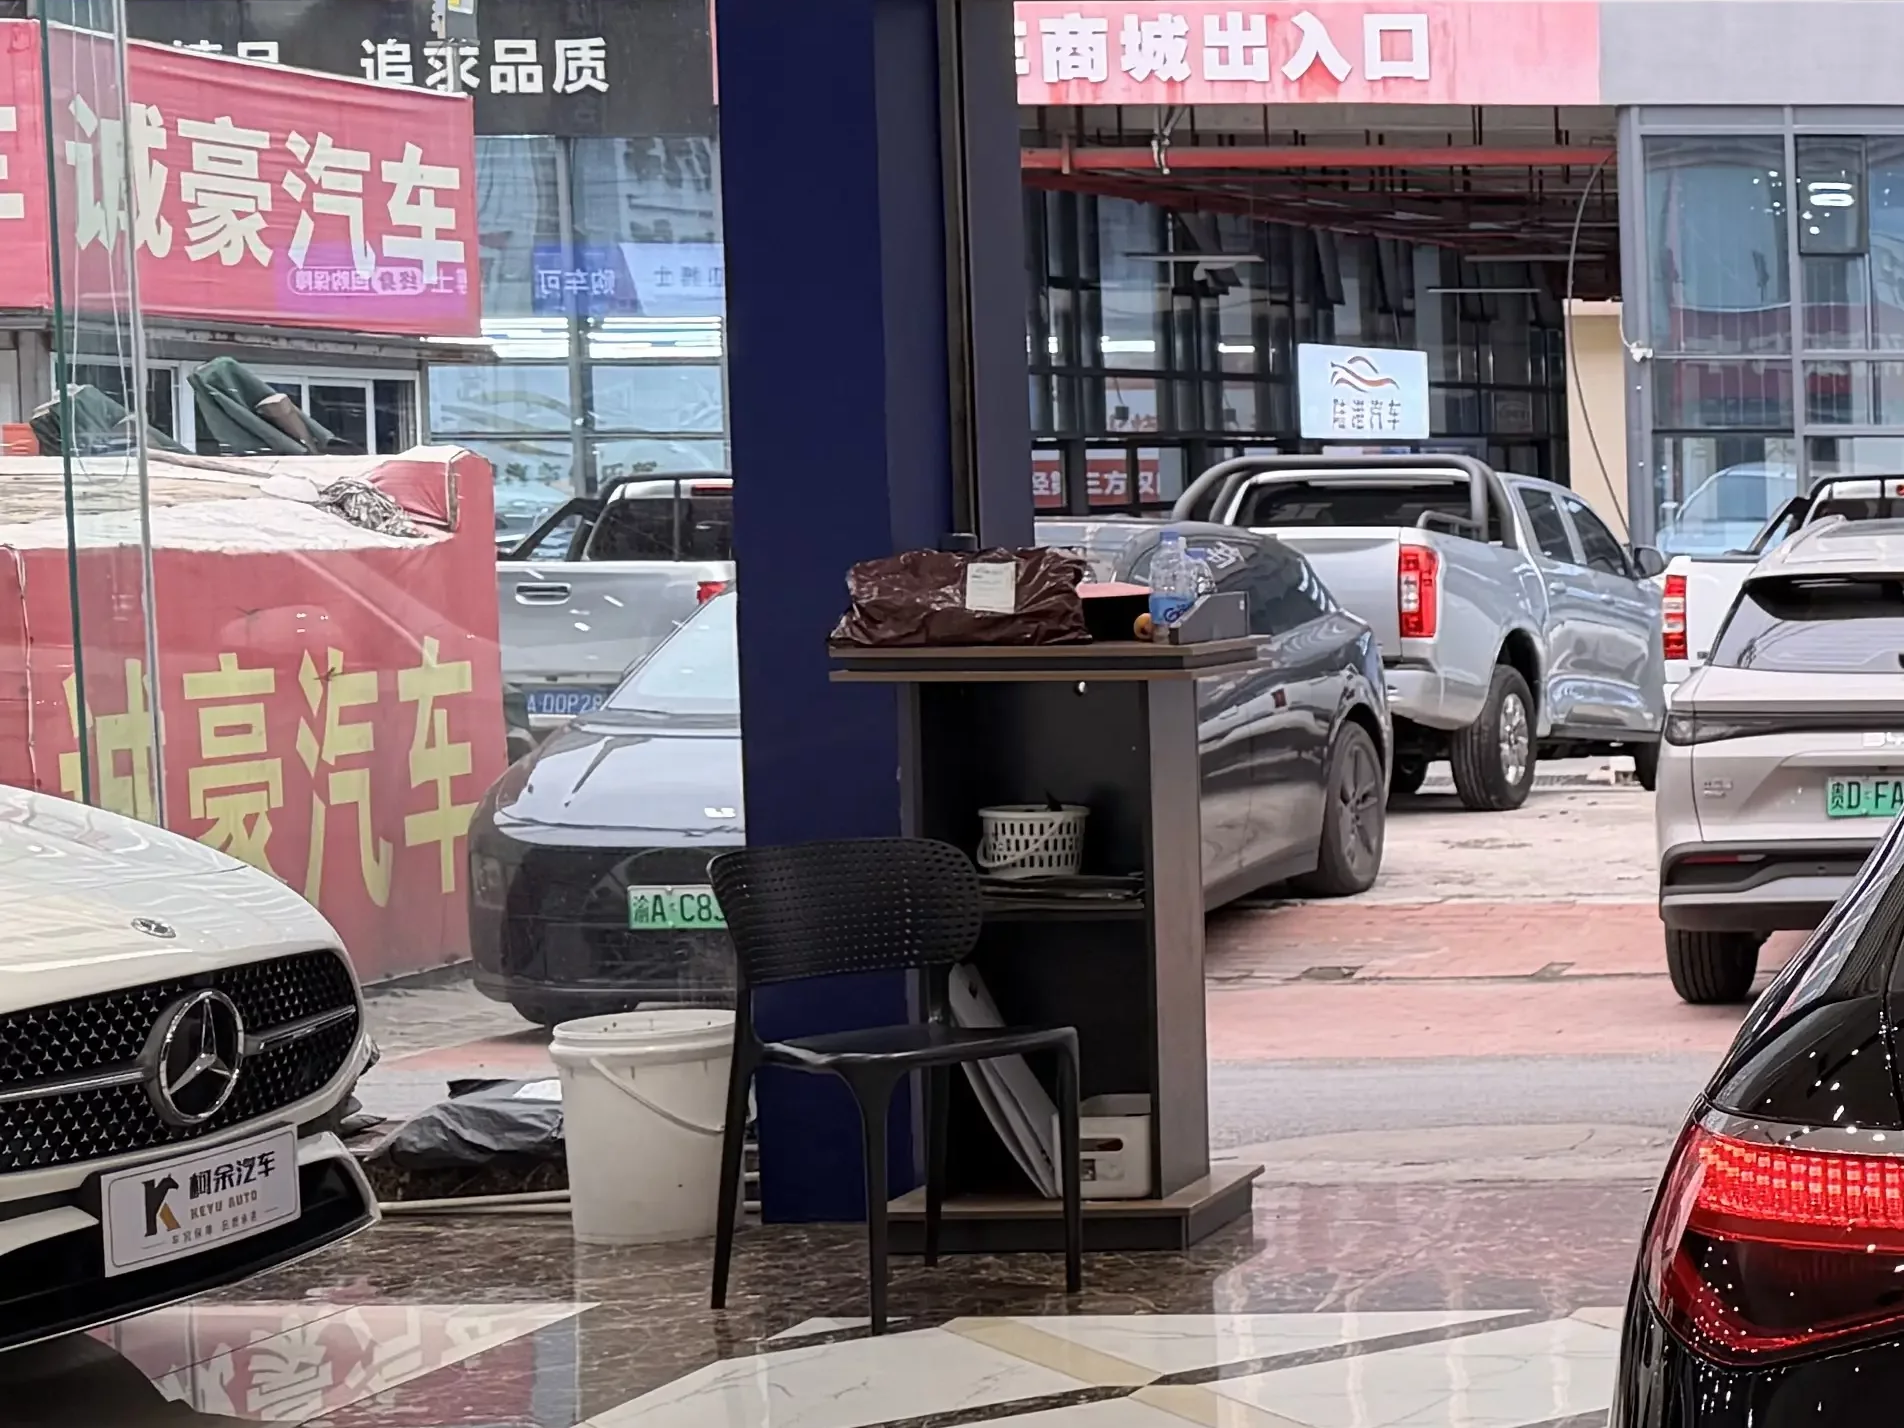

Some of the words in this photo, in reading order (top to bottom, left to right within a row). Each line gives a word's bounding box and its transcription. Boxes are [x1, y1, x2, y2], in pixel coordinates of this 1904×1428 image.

[360, 37, 610, 95] 追求品质
[1014, 11, 1431, 84] 商城出入口
[65, 93, 466, 286] 诚豪汽车
